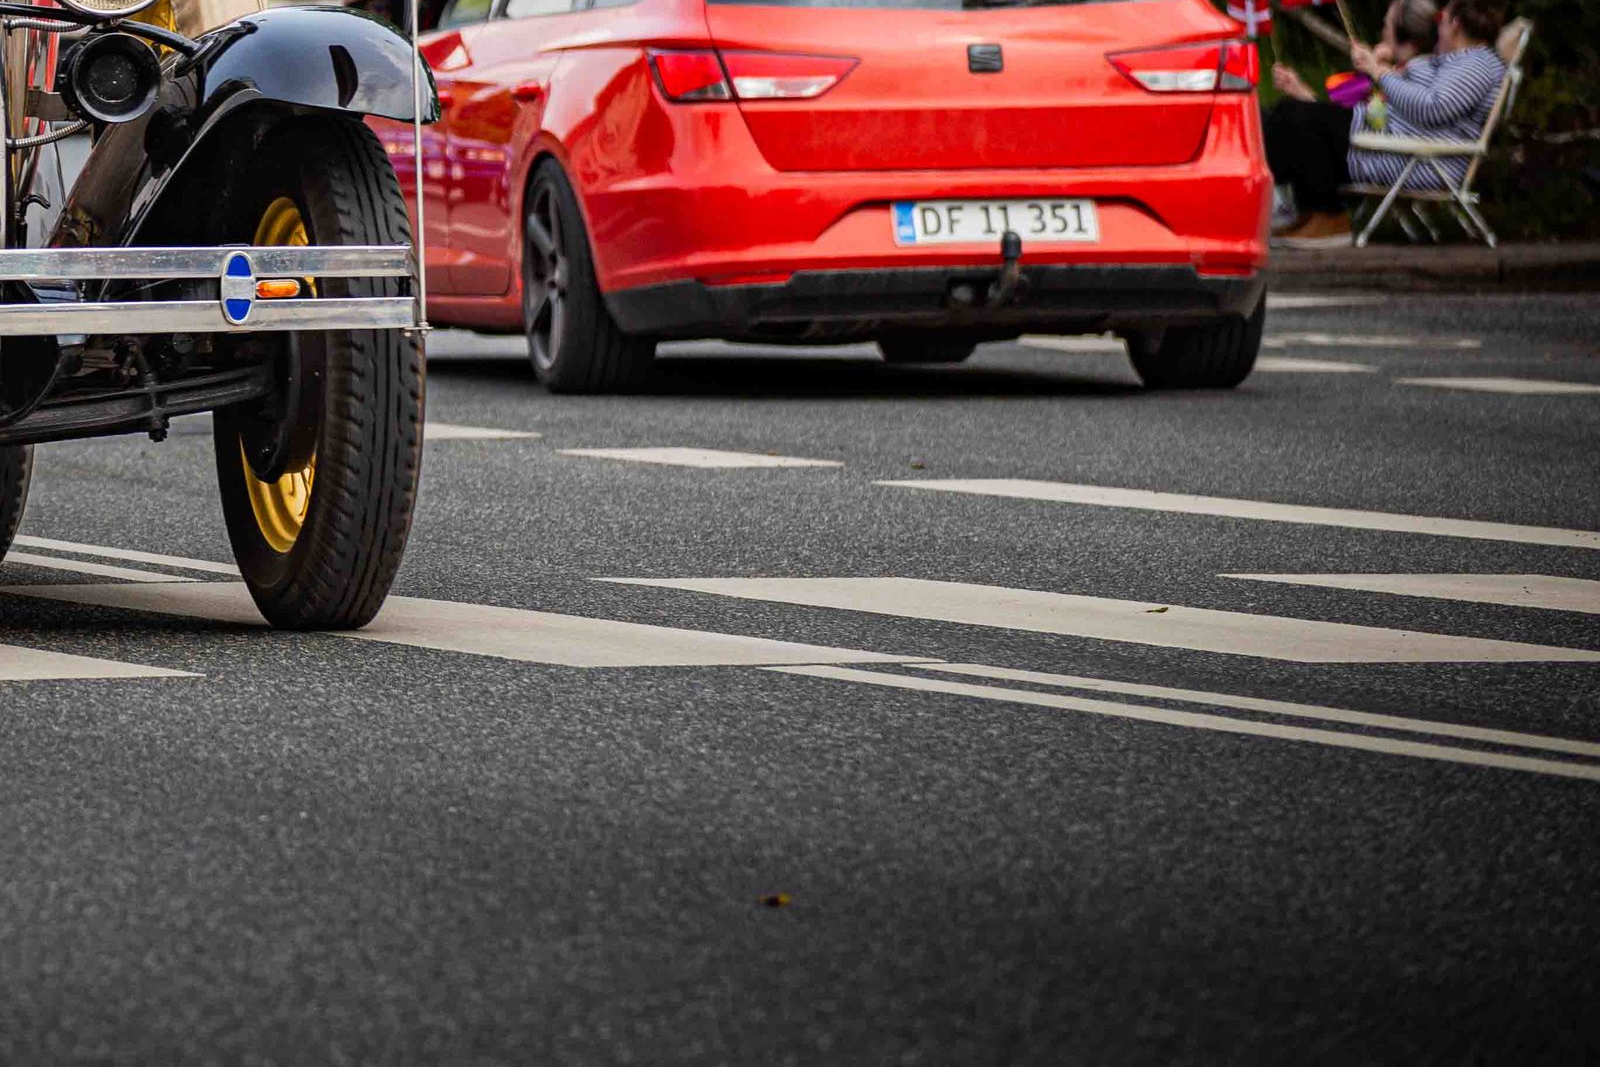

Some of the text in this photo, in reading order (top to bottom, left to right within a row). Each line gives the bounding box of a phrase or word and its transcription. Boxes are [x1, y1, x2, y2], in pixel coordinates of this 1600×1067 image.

[920, 203, 1088, 235] DF 11 351
